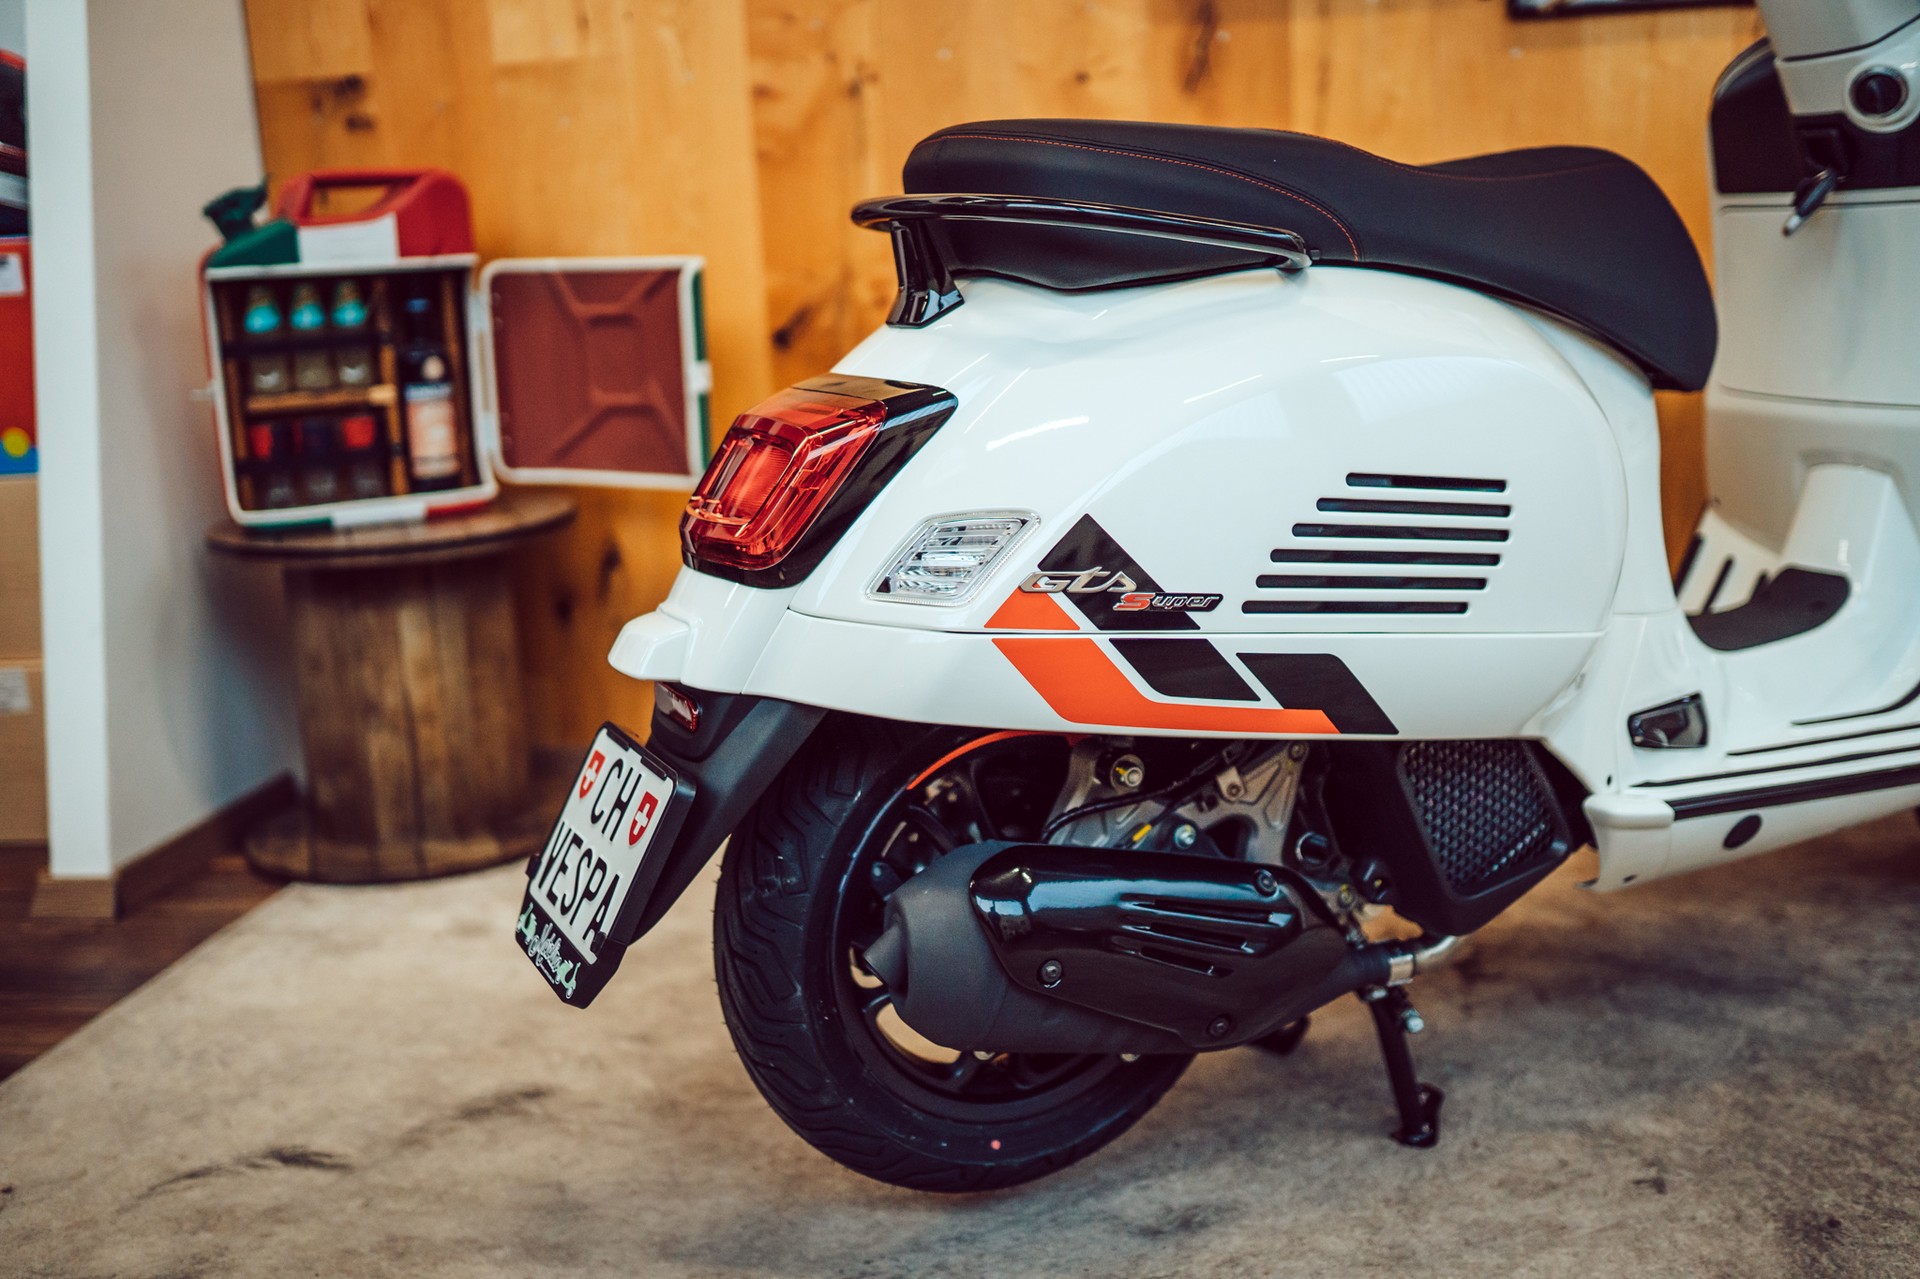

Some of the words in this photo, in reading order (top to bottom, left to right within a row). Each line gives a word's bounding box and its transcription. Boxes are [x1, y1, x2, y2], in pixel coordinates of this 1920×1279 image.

[1112, 592, 1220, 611] Super
[590, 758, 642, 842] CH
[538, 821, 620, 945] VESPA
